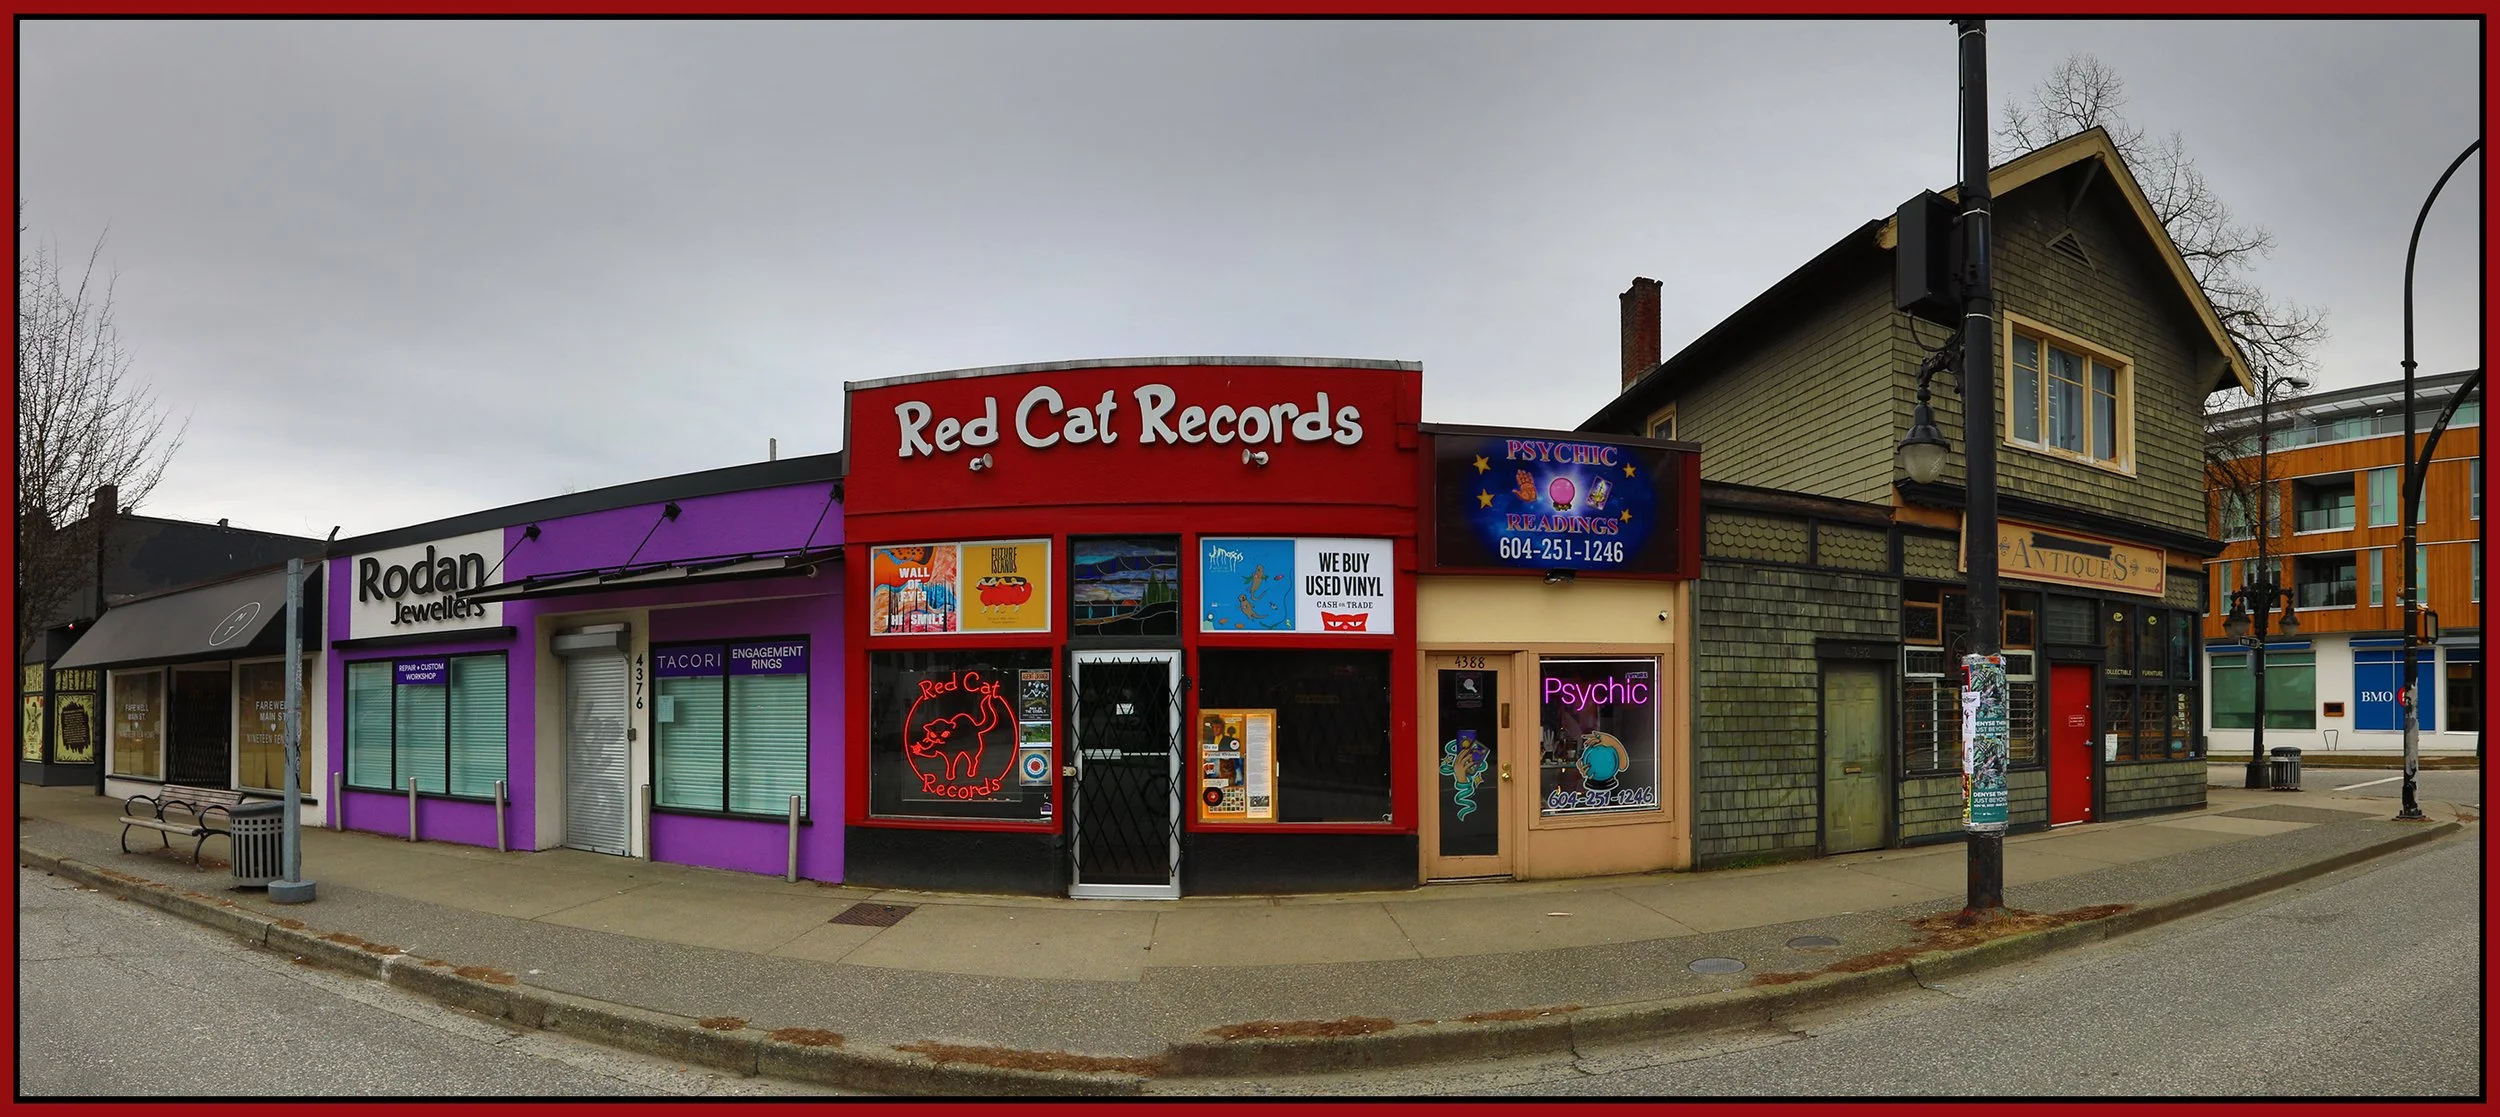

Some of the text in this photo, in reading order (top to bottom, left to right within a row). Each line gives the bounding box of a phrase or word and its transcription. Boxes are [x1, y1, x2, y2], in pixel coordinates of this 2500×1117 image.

[894, 383, 1363, 457] Red Cat Records
[1506, 439, 1618, 467] PSYCHIC
[1506, 513, 1619, 536] READINGS
[1500, 537, 1624, 562] 604-251-1246
[1319, 551, 1370, 573] WE BUY
[2010, 537, 2128, 582] ANTIQUES
[359, 544, 485, 602] Rodan
[900, 567, 930, 579] WALL
[908, 579, 921, 590] OF
[1306, 575, 1384, 597] USED VINYL
[900, 590, 928, 602] EYES
[1316, 600, 1338, 609] CASH
[1346, 601, 1374, 609] TRADE
[390, 595, 486, 625] Jewellers
[884, 613, 945, 626] THE SMILE
[657, 653, 721, 669] TACORI
[732, 646, 803, 659] ENGAGEMENT
[398, 663, 444, 672] REPAIR CUSTOM
[751, 659, 782, 670] RINGS
[1454, 656, 1486, 669] 4388
[406, 673, 436, 681] WORKSHOP
[636, 653, 644, 710] 4376
[919, 671, 1000, 700] Red Cat
[1544, 677, 1648, 711] Psychic
[2361, 691, 2393, 702] BMO
[255, 701, 285, 710] FAREWE
[260, 712, 276, 721] MAIN
[922, 773, 1001, 799] Records
[1548, 786, 1653, 808] 604-251-1246
